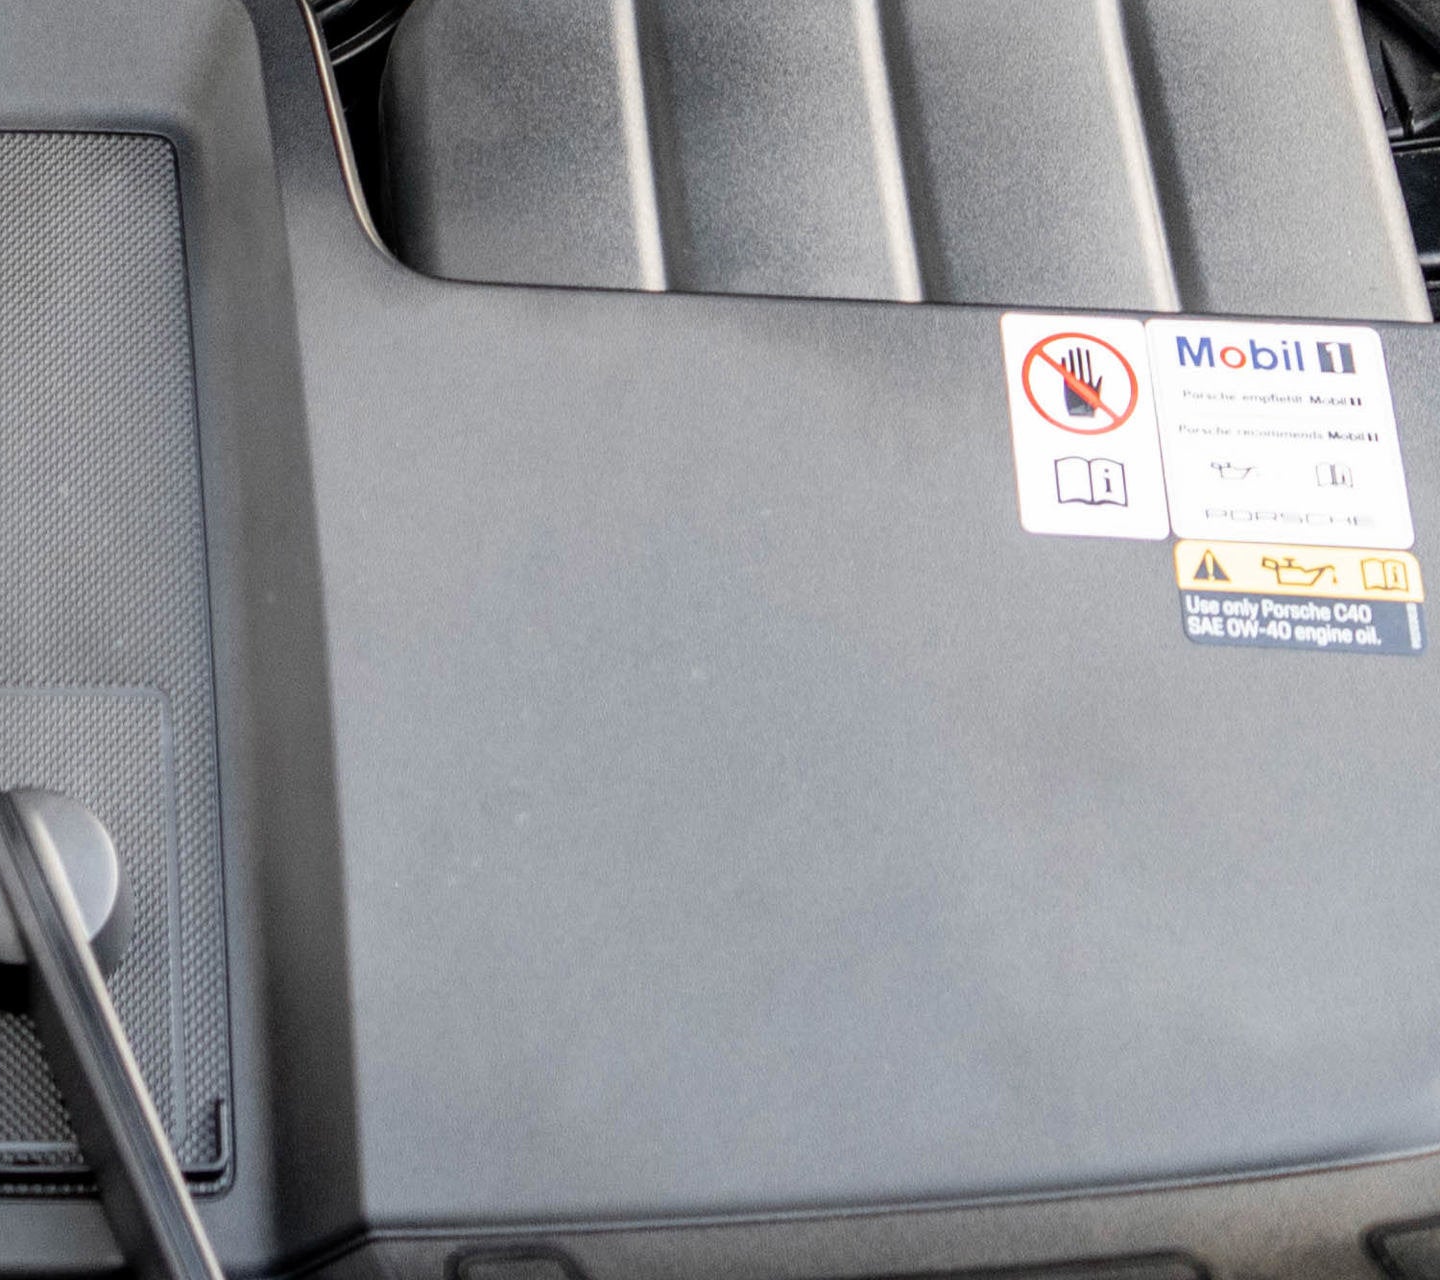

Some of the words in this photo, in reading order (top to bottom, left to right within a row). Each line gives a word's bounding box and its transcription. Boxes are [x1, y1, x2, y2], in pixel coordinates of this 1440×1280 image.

[1175, 335, 1306, 372] Mobil
[1205, 507, 1376, 528] PORSCHE
[1185, 594, 1220, 615] Use
[1222, 597, 1258, 619] only
[1260, 598, 1331, 622] Porsche
[1333, 603, 1373, 624] C40
[1186, 616, 1225, 636] SAE
[1226, 619, 1292, 640] 0W-40
[1293, 625, 1353, 647] engine
[1355, 626, 1382, 646] oil.
